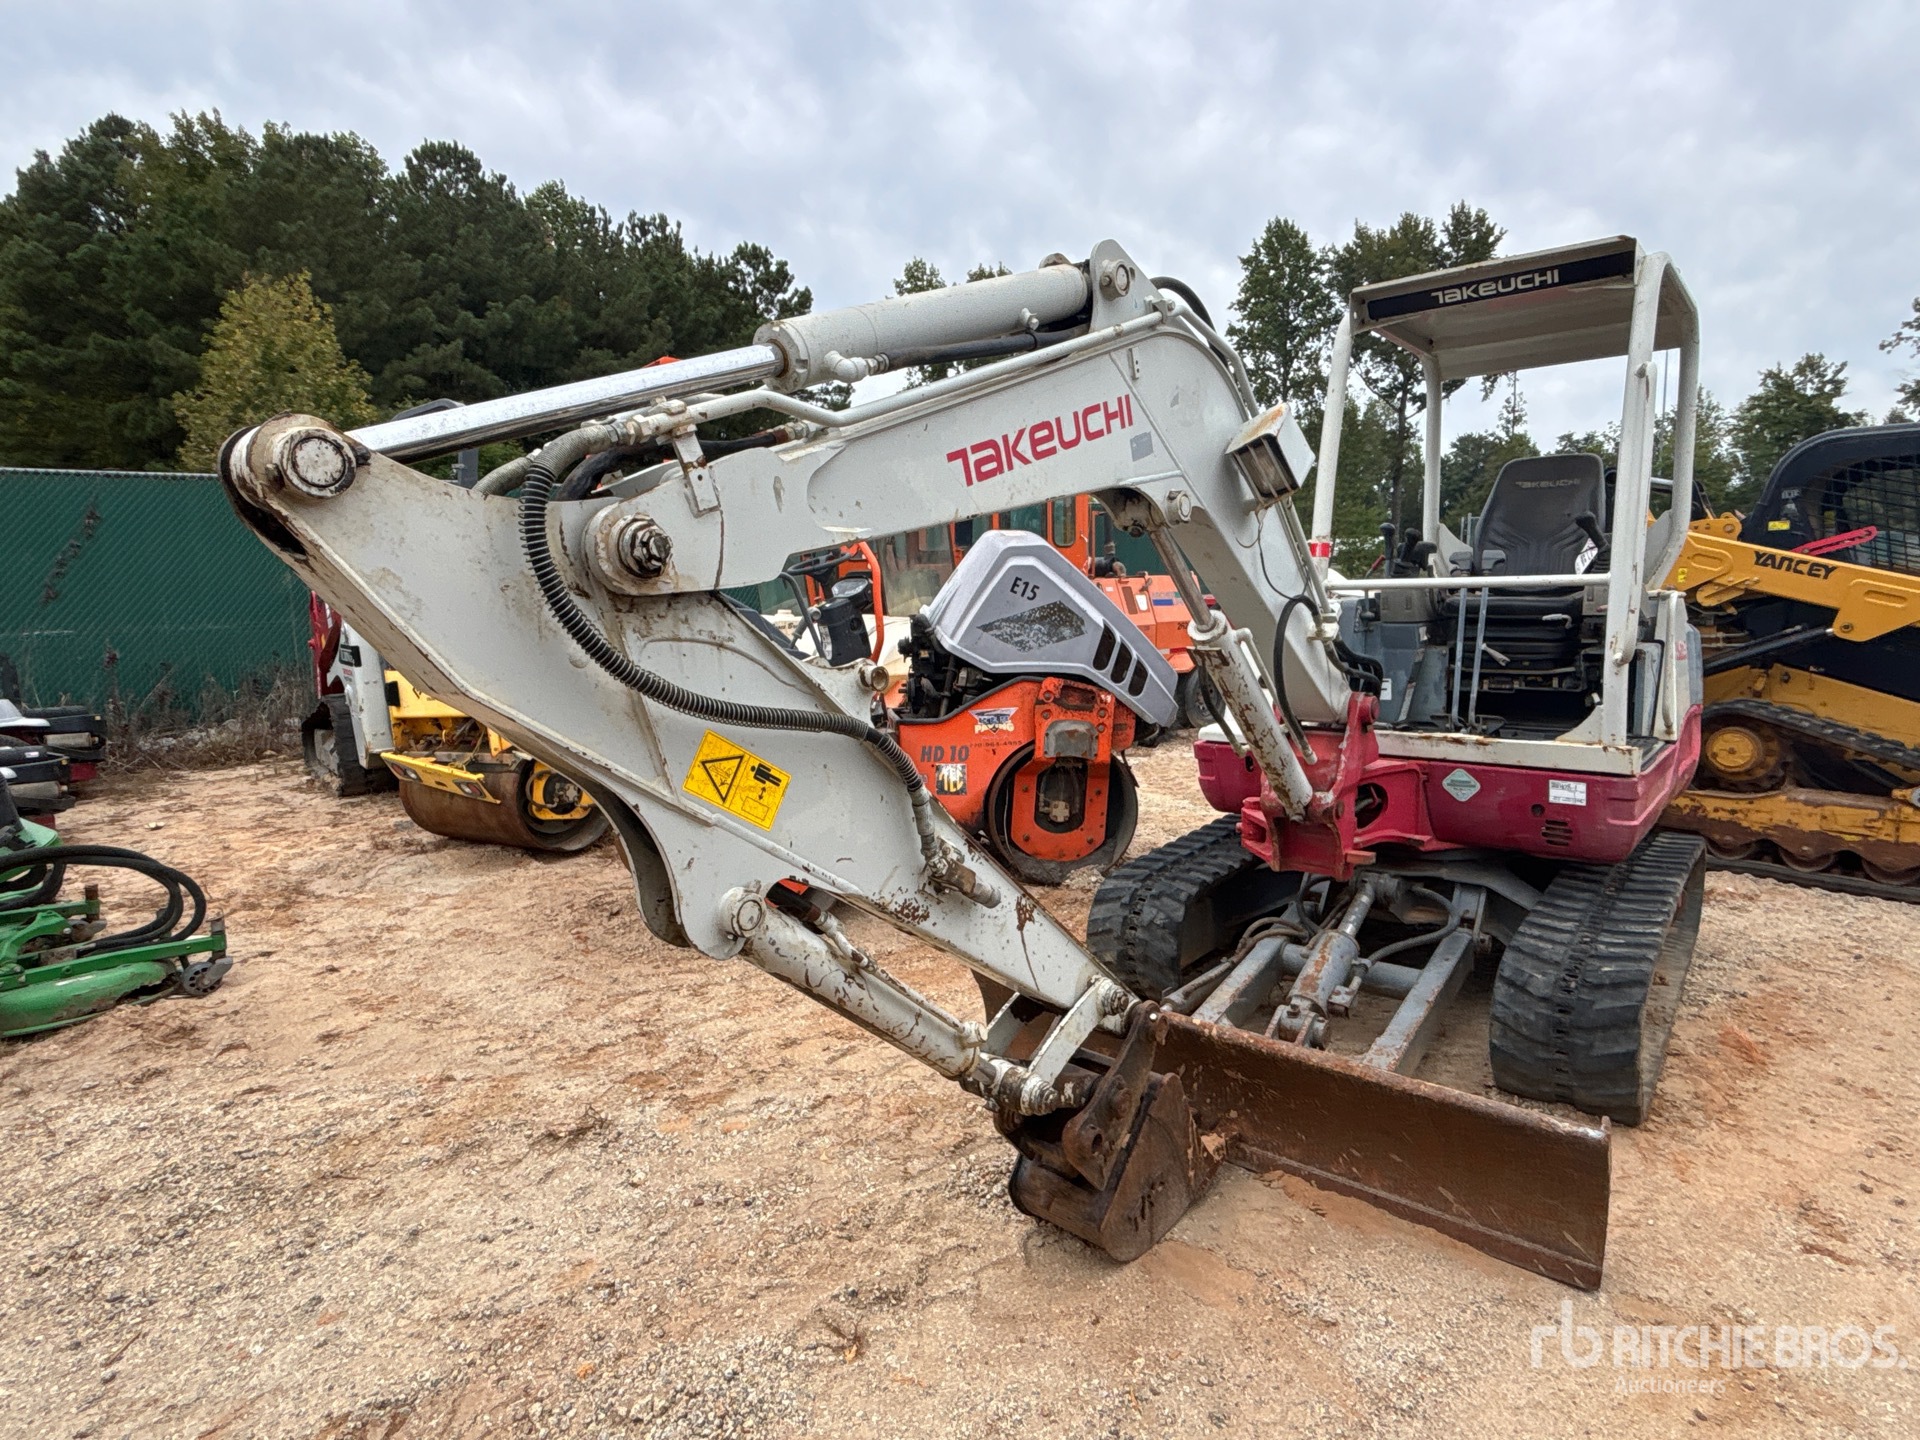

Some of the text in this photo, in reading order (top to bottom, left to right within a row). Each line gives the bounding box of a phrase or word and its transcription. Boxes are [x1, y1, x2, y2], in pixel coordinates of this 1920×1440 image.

[1431, 268, 1560, 305] TAKEUCHI
[946, 394, 1134, 487] TAKEUCHI
[1753, 550, 1839, 580] YANCEY
[1010, 576, 1040, 601] E15
[921, 744, 970, 762] HD 10
